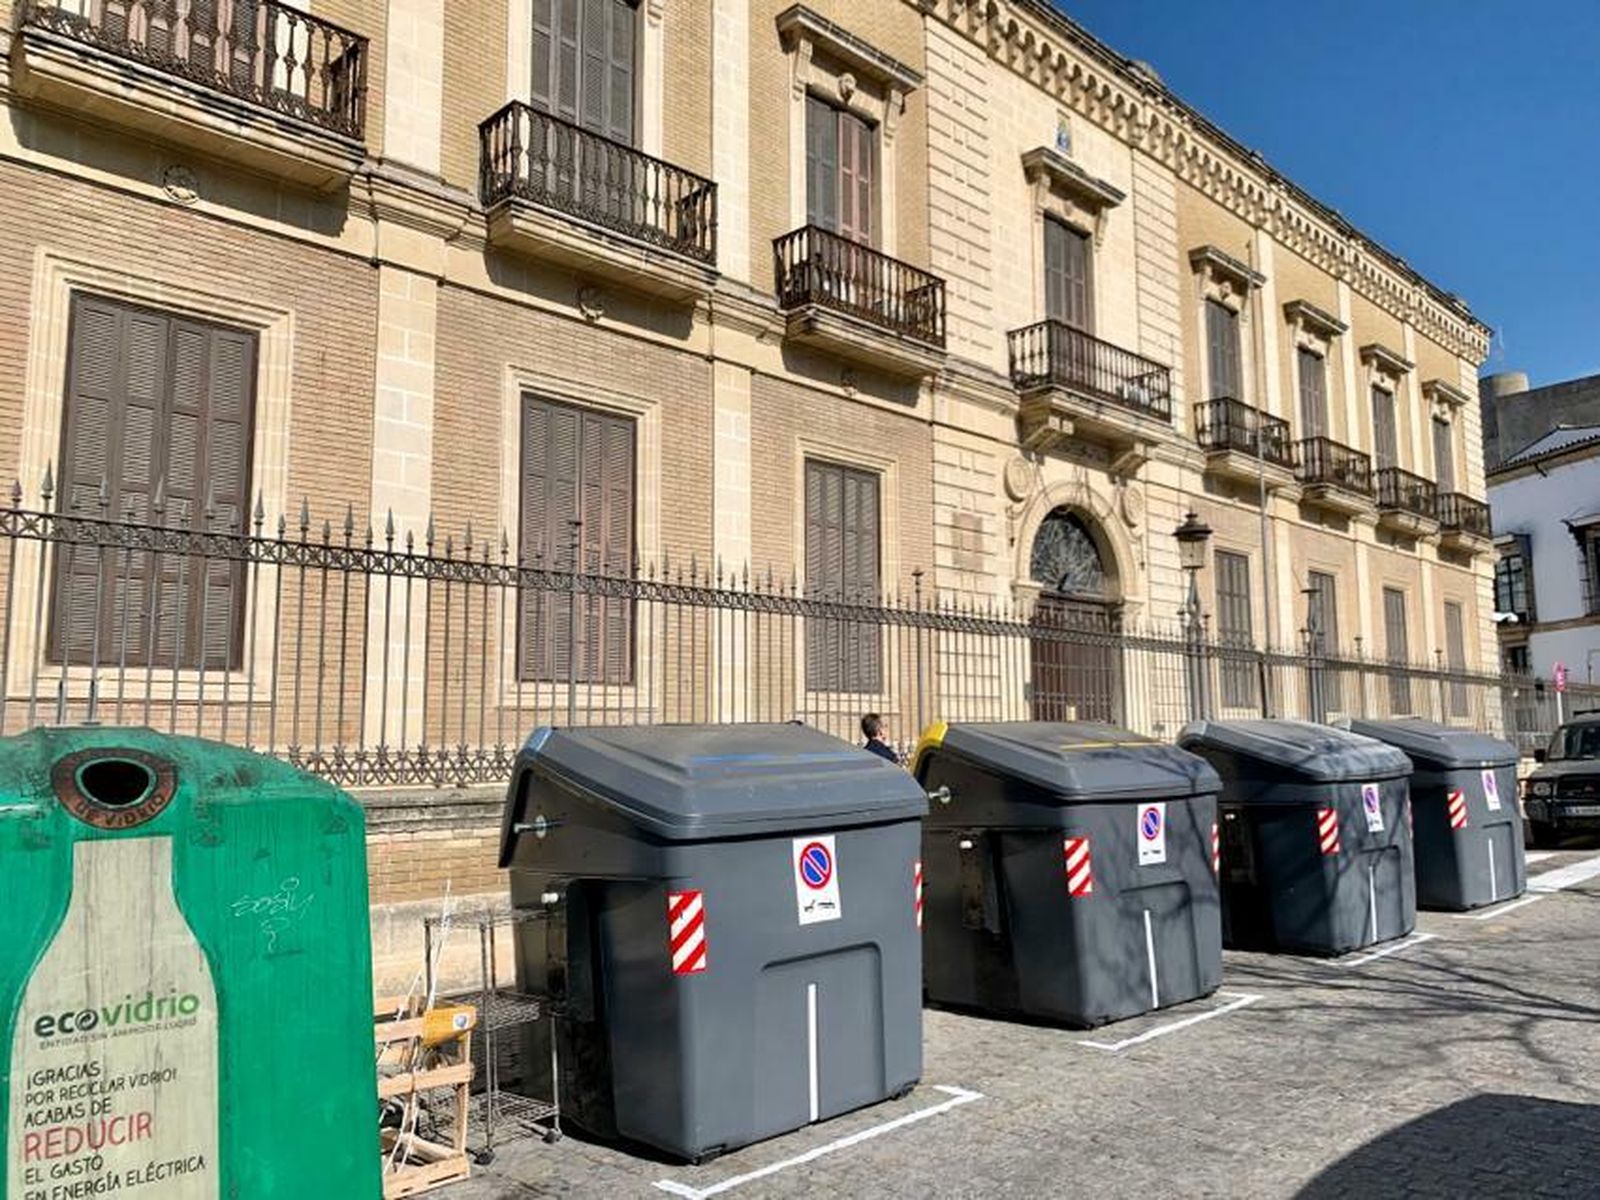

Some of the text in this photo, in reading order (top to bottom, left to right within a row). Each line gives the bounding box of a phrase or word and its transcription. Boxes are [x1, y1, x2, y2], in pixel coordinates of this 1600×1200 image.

[34, 988, 199, 1037] ecovidrio
[25, 1068, 177, 1107] POR RECICLAR VIDRIO!
[27, 1061, 100, 1090] ¡GRACIAS
[24, 1097, 112, 1128] ACABAS DE
[24, 1111, 152, 1163] REDUCIR
[25, 1155, 104, 1185] EL GASTO
[52, 1171, 121, 1200] ENERGÍA
[126, 1155, 206, 1187] ELÉCTRICA
